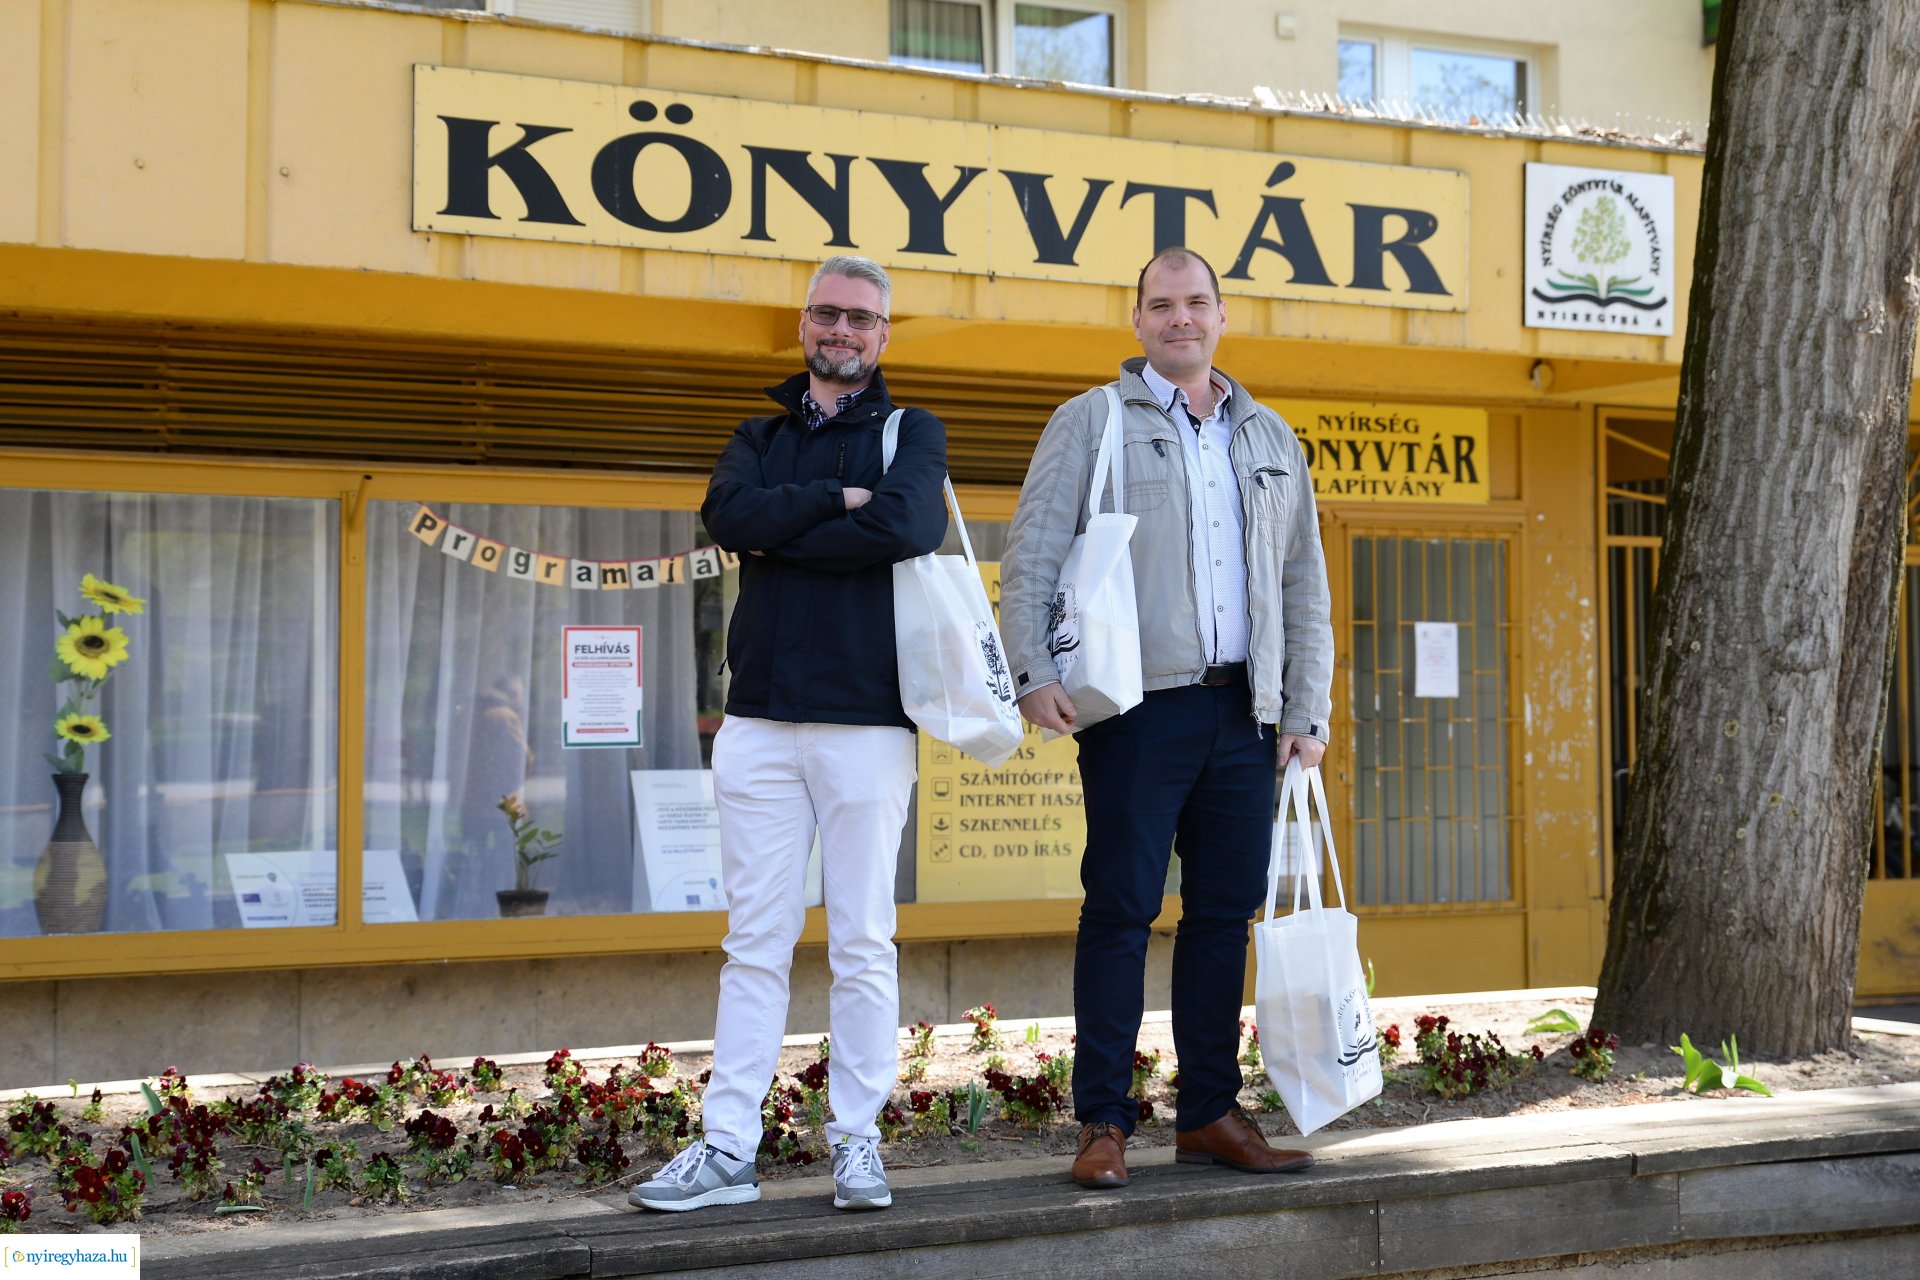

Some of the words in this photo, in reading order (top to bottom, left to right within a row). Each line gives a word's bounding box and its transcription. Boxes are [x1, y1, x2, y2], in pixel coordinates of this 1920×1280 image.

[436, 100, 1453, 296] KÖNYVTÁR
[1318, 411, 1420, 434] NYÍRSÉG
[1294, 427, 1480, 484] ÖNYVTÁR
[1313, 474, 1445, 497] LAPÍTVÁNY
[574, 642, 630, 654] FELHÍVÁS
[960, 769, 1064, 786] SZÁMÍTÓGÉP
[959, 794, 1036, 807] INTERNET
[1041, 793, 1085, 806] HASZ
[959, 814, 1062, 831] SZKENNELÉS
[993, 844, 1029, 857] DVD
[1034, 840, 1072, 857] ÍRÁS
